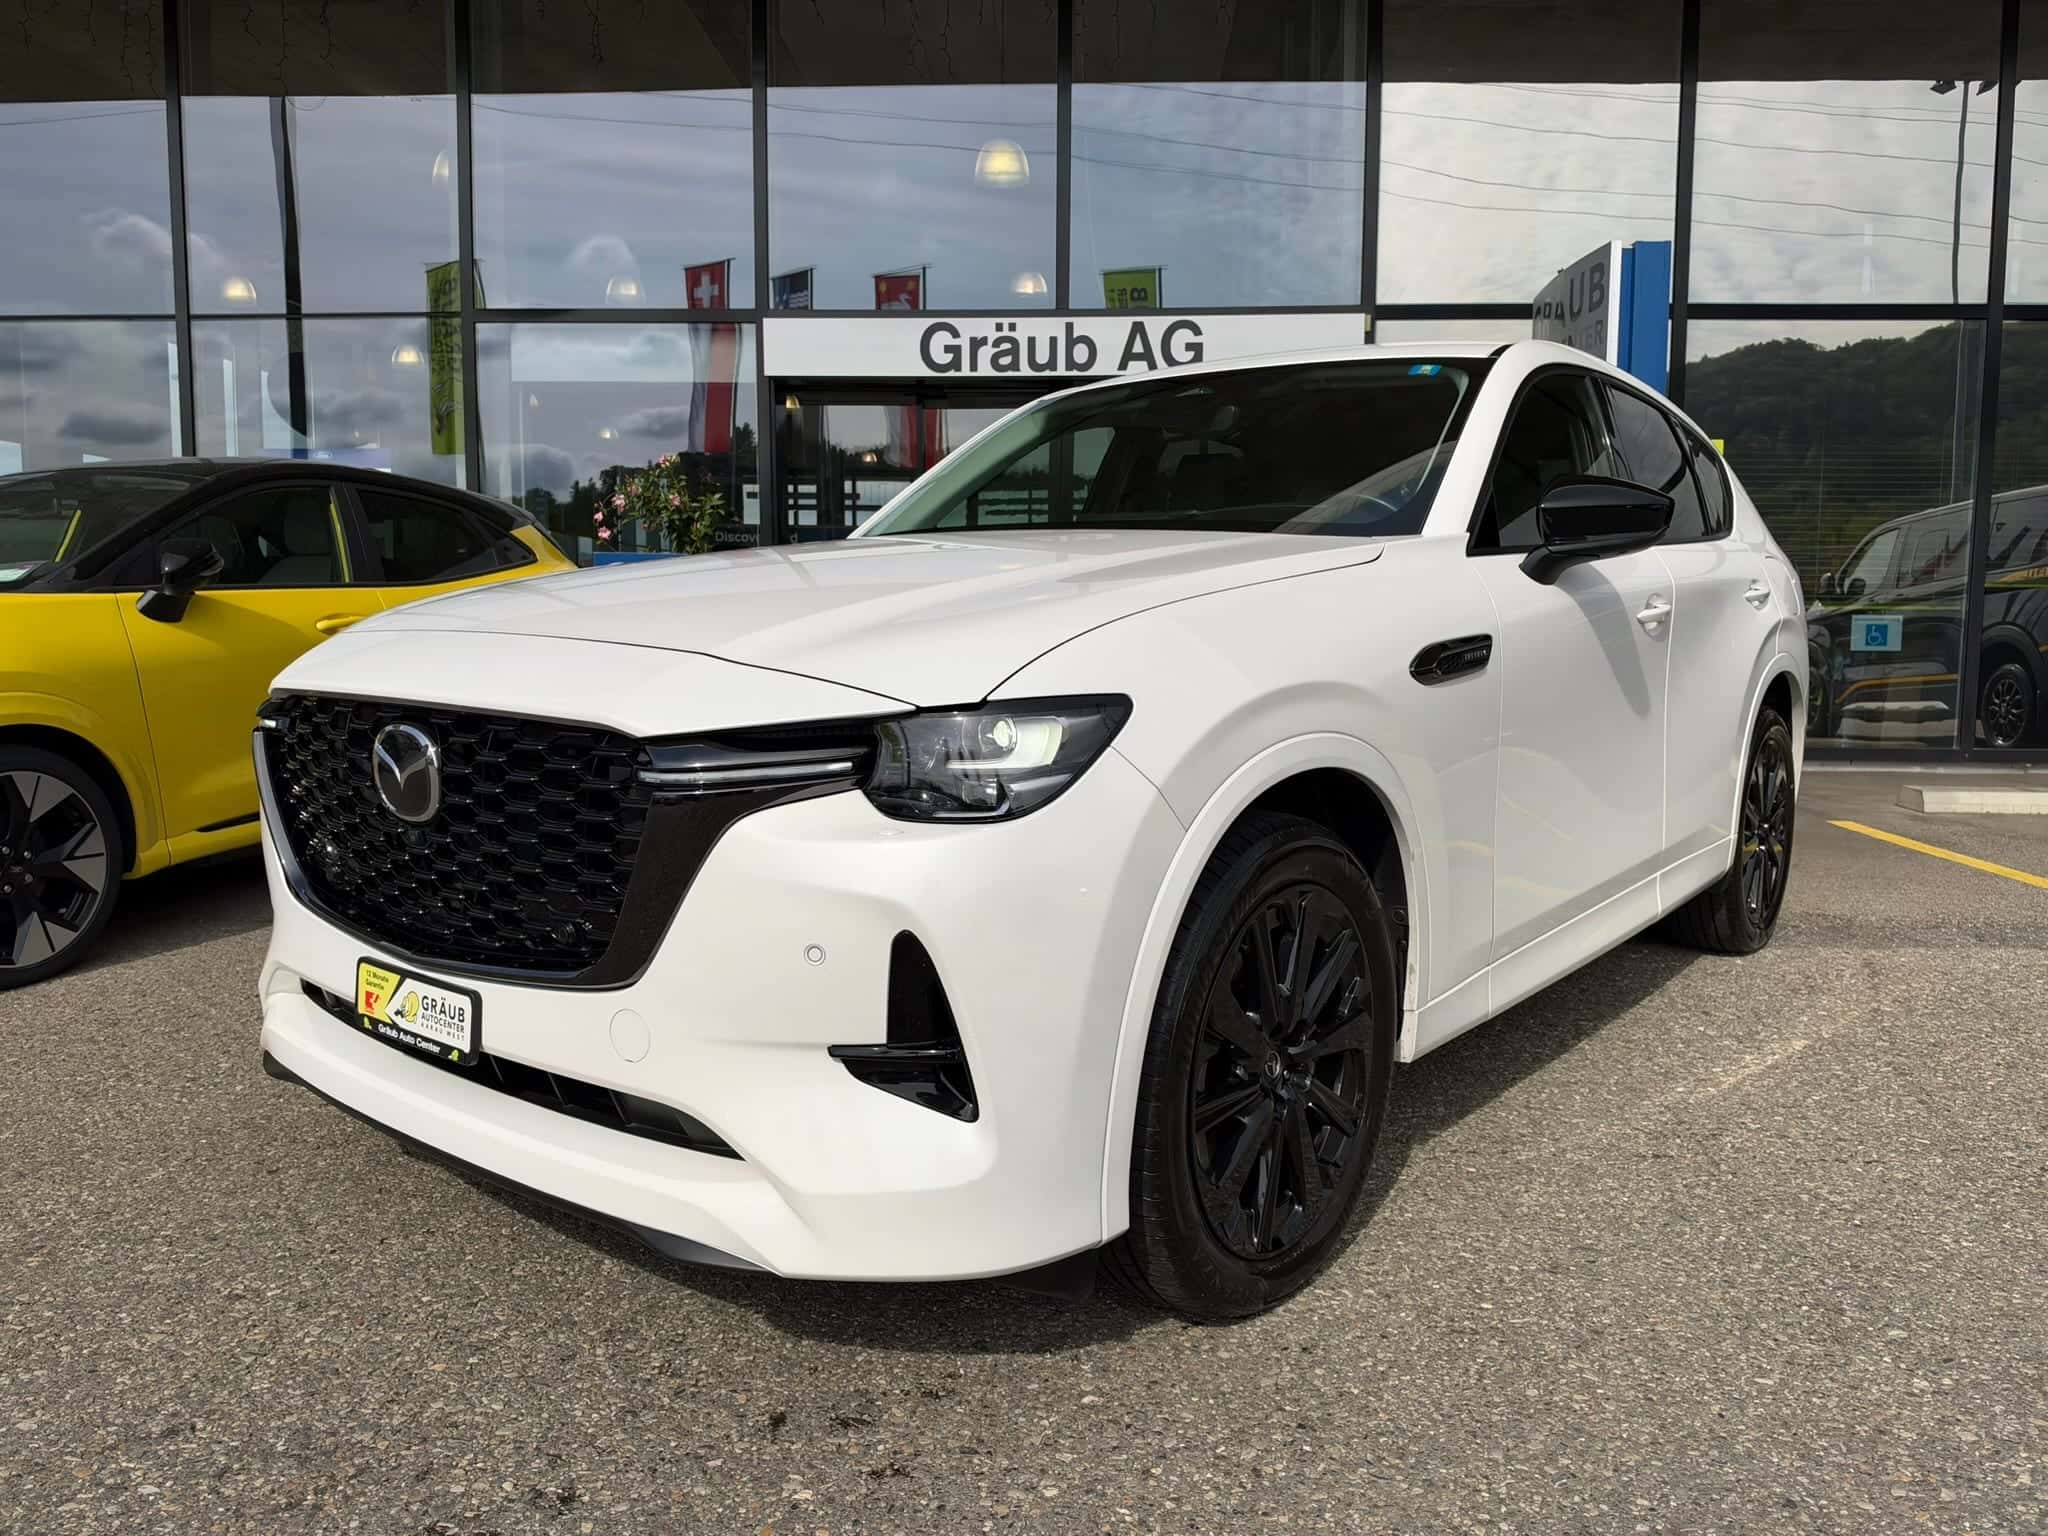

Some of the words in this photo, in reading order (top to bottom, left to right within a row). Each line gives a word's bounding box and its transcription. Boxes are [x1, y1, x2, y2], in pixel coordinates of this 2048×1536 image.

[920, 321, 1098, 374] Gräub
[1116, 319, 1204, 372] AG
[421, 995, 465, 1023] GRÄUB
[421, 1012, 465, 1034] AUTOCENTER
[399, 1031, 415, 1045] Auto
[416, 1037, 441, 1054] Center
